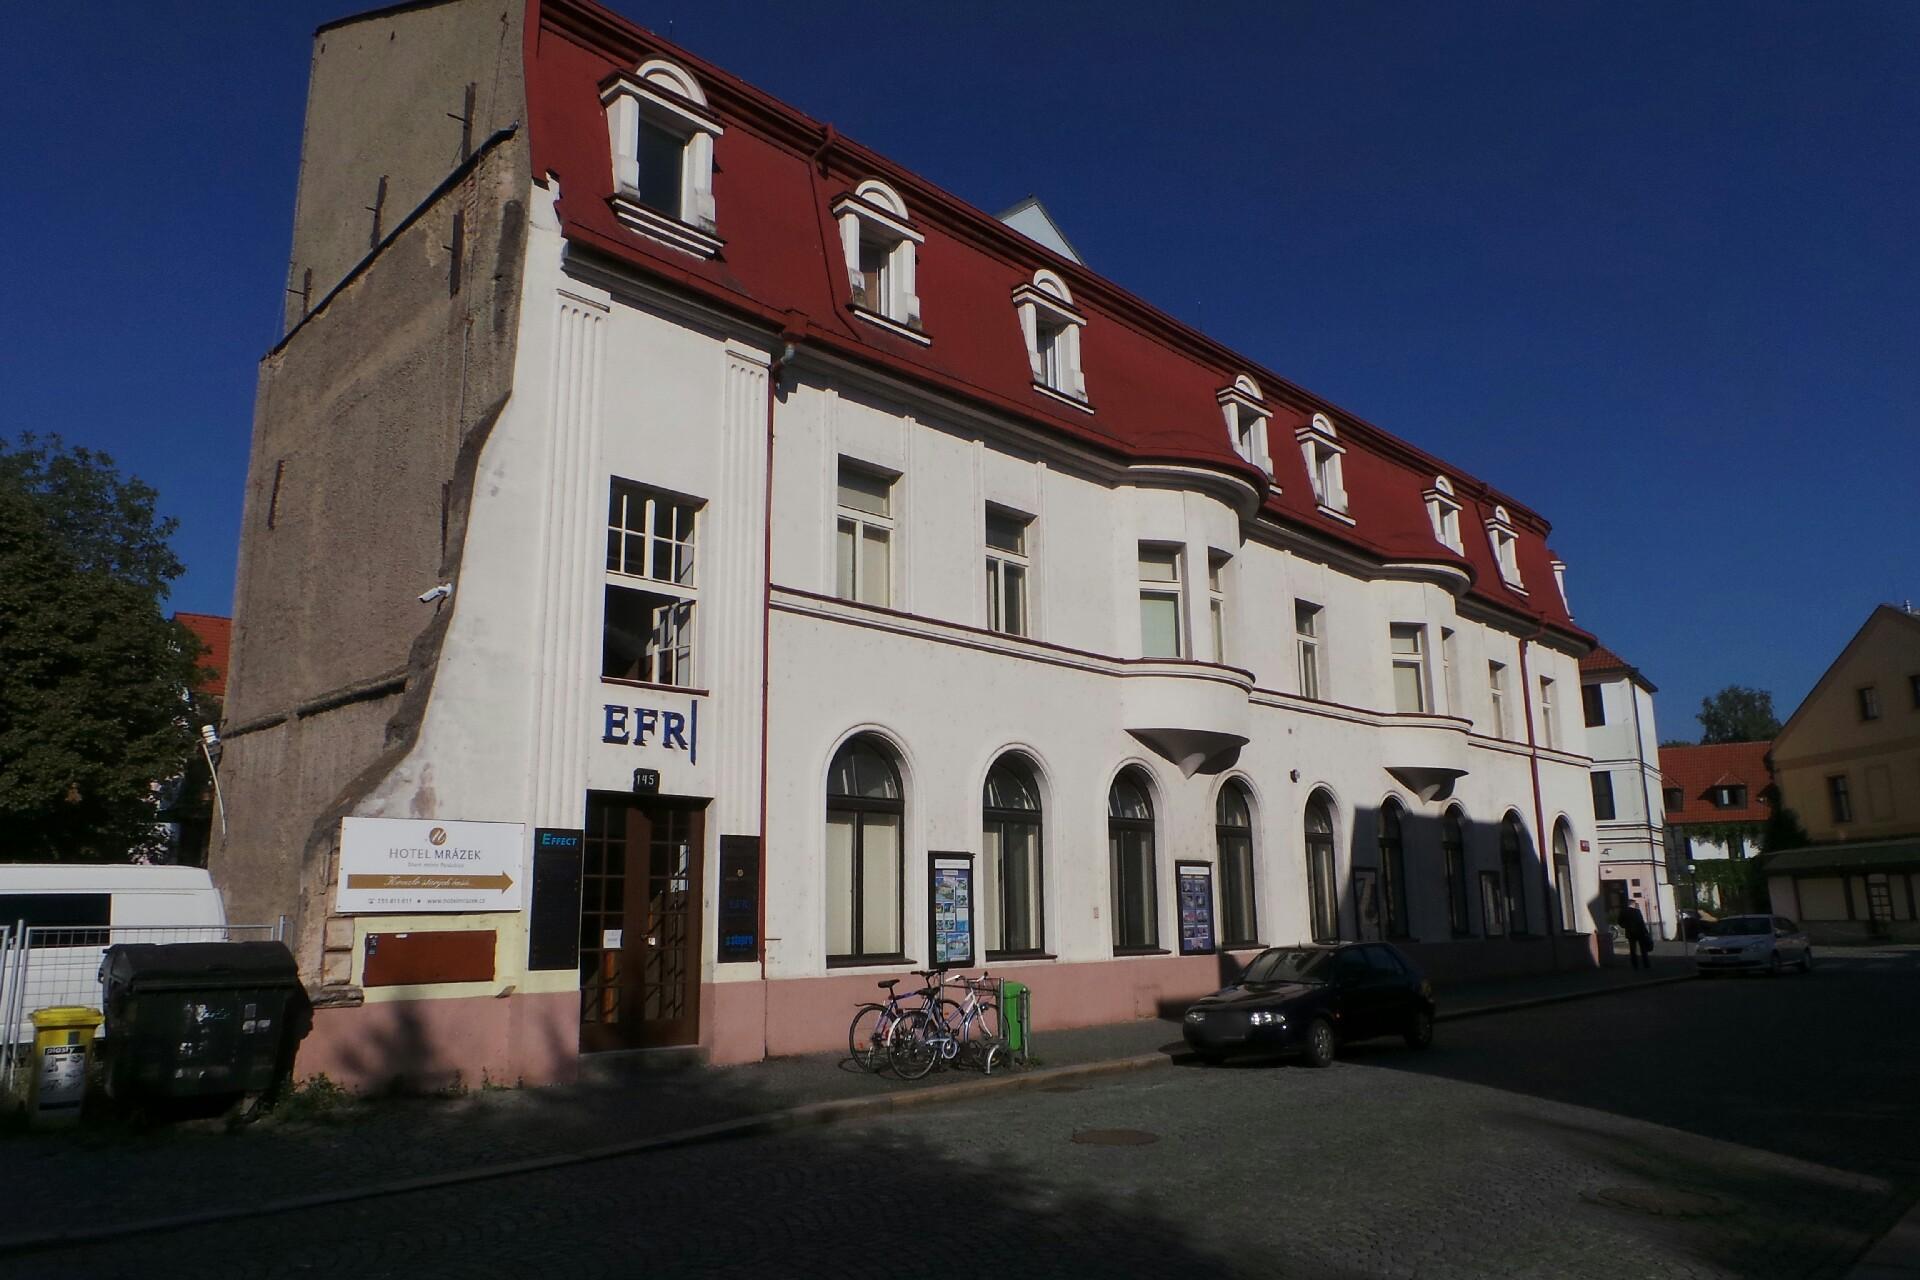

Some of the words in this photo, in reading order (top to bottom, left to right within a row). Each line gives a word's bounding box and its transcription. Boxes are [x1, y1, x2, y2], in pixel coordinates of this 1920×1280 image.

[636, 774, 655, 785] 145
[389, 848, 431, 859] HOTEL
[434, 848, 481, 860] MRÁZEK
